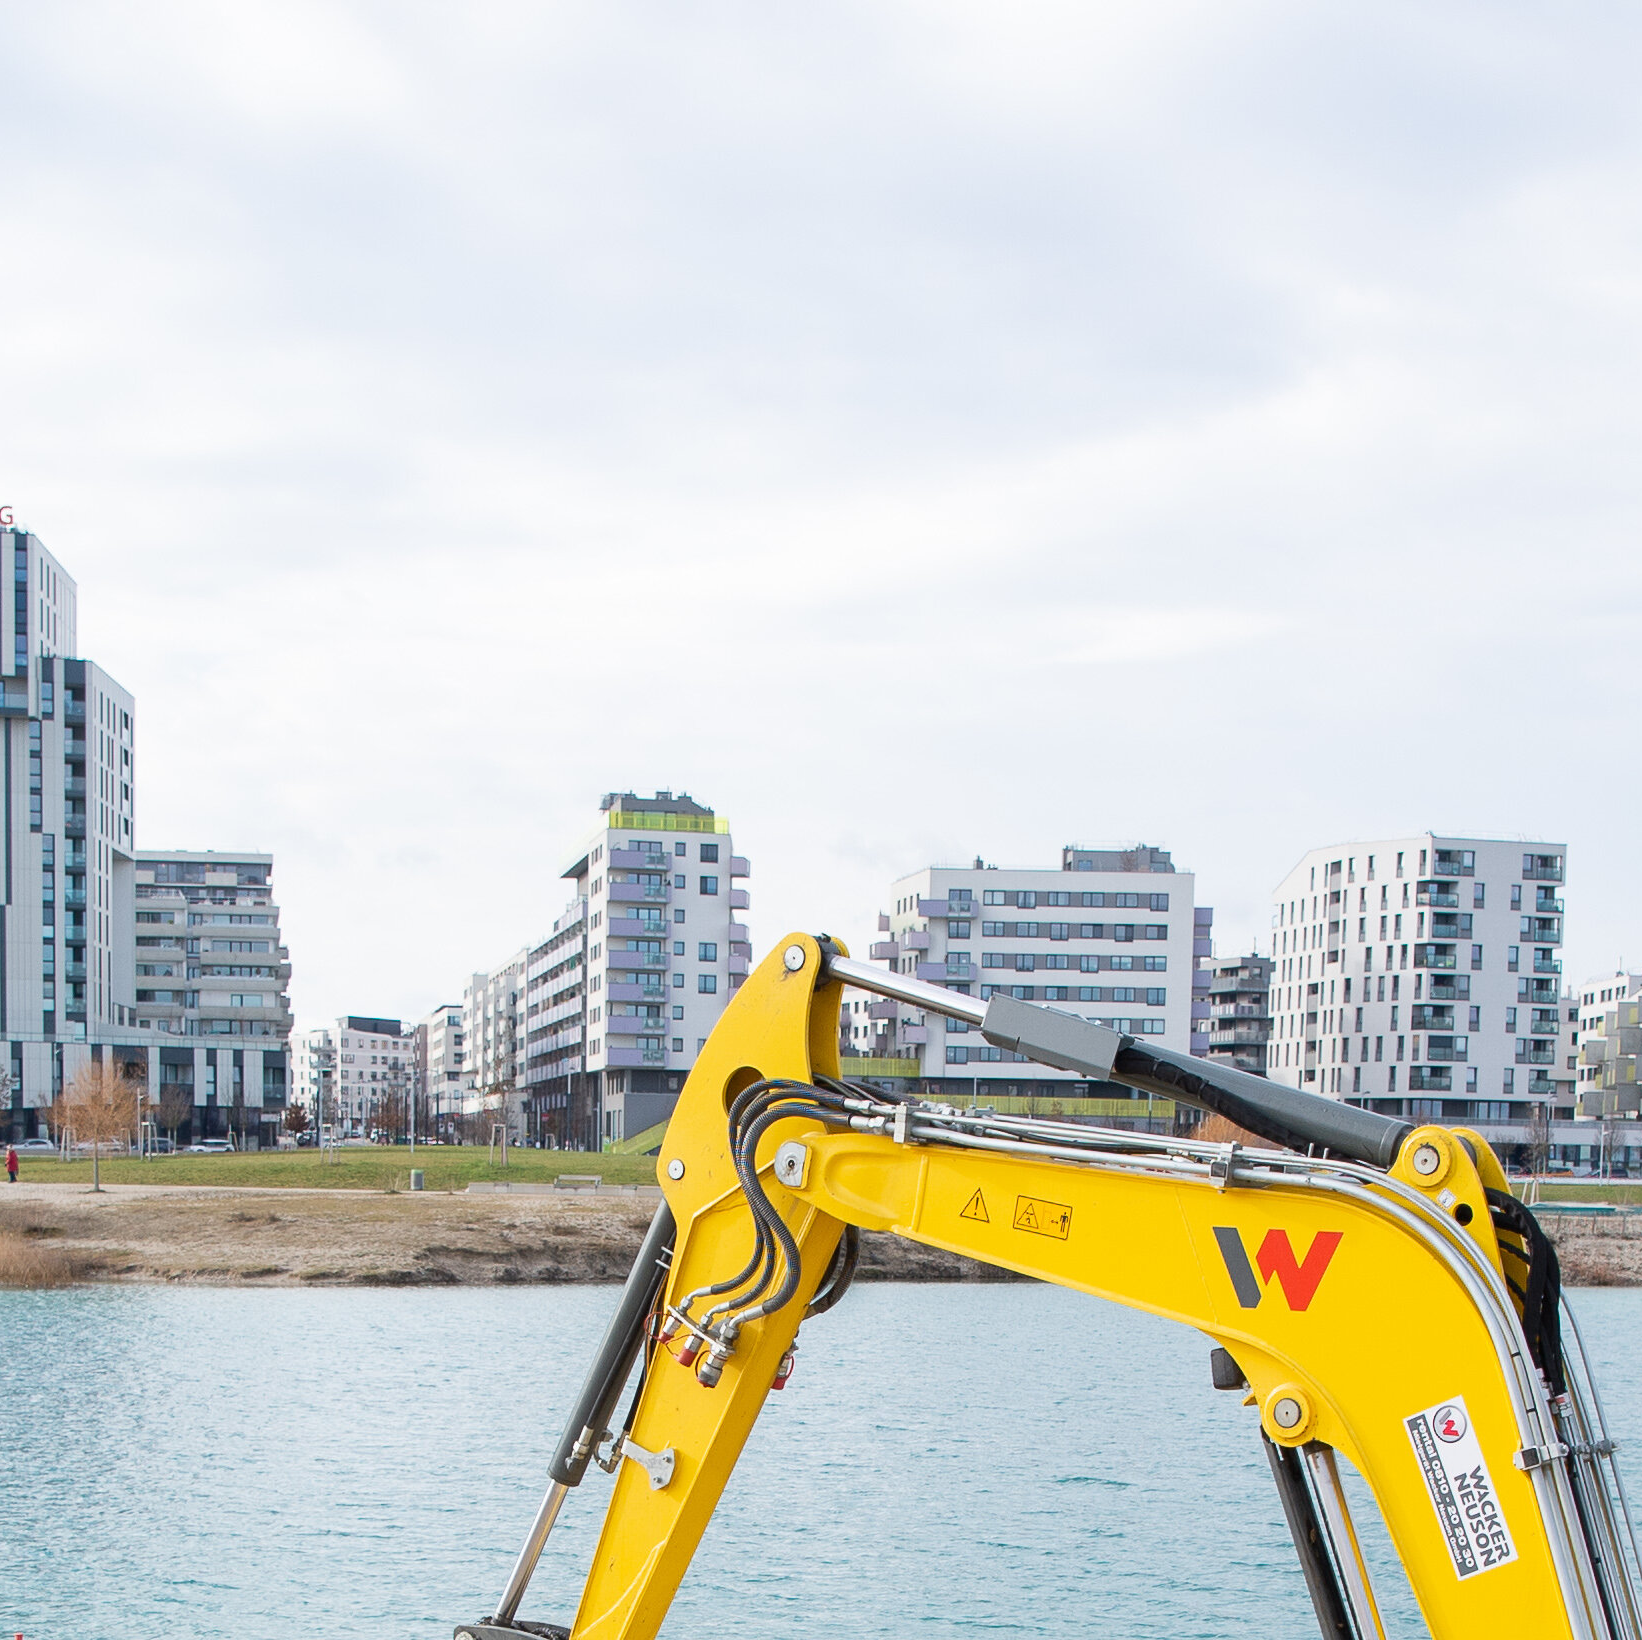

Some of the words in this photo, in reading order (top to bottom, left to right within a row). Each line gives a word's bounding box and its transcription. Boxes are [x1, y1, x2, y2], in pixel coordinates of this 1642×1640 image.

[1416, 1418, 1437, 1458] rental
[1431, 1459, 1449, 1495] 0810
[1447, 1505, 1460, 1525] 20
[1454, 1528, 1467, 1547] 20
[1462, 1549, 1475, 1568] 30
[1427, 1471, 1442, 1504] Wacker
[1438, 1504, 1453, 1537] Neuson
[1449, 1537, 1463, 1564] GmbH
[1454, 1472, 1497, 1567] NEUSON
[1469, 1465, 1510, 1562] WACKER
